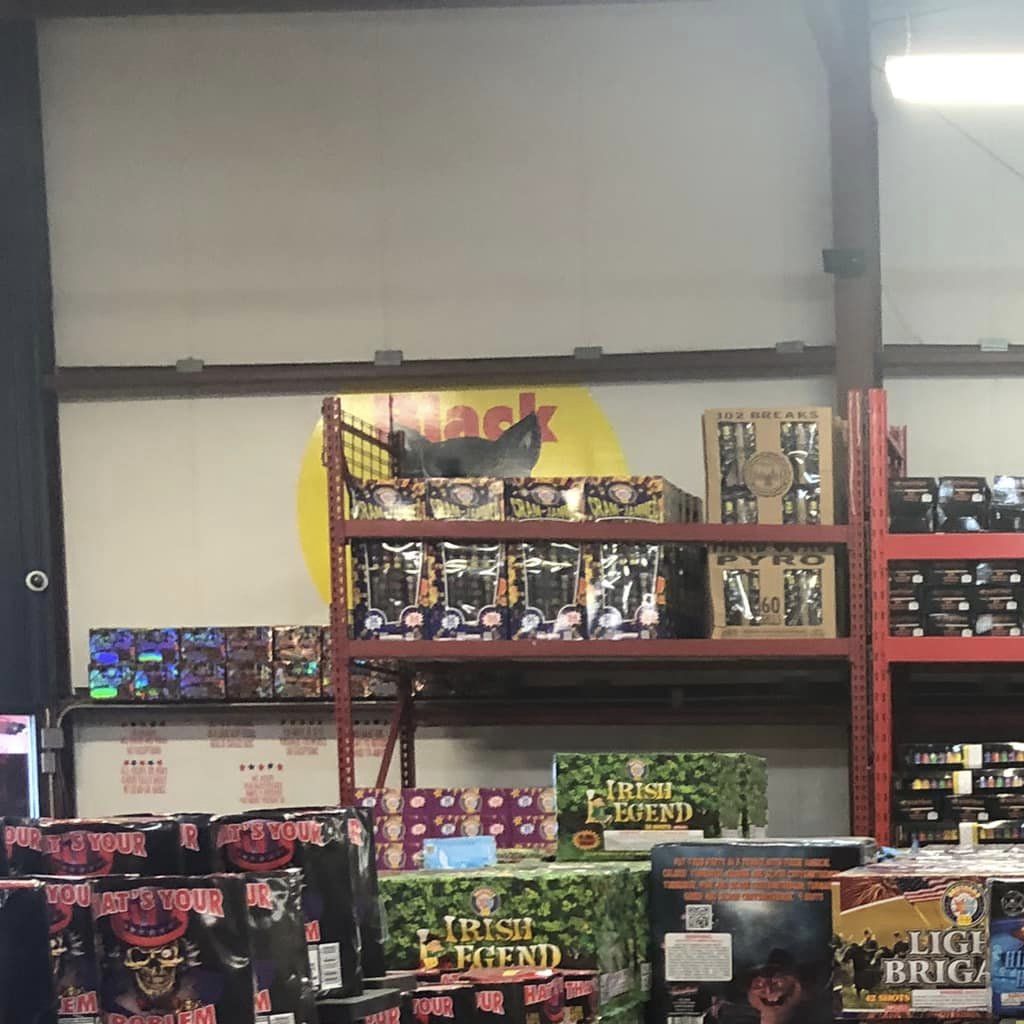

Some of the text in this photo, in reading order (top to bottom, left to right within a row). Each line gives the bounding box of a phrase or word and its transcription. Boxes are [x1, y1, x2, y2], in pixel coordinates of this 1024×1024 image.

[751, 411, 819, 420] BREAKS
[717, 555, 825, 566] PYRO
[606, 780, 672, 800] IRISH
[89, 831, 147, 857] YOUR
[159, 888, 224, 918] YOUR
[443, 915, 534, 943] IRISH
[908, 930, 986, 955] LIGH
[884, 959, 990, 984] BRIGA
